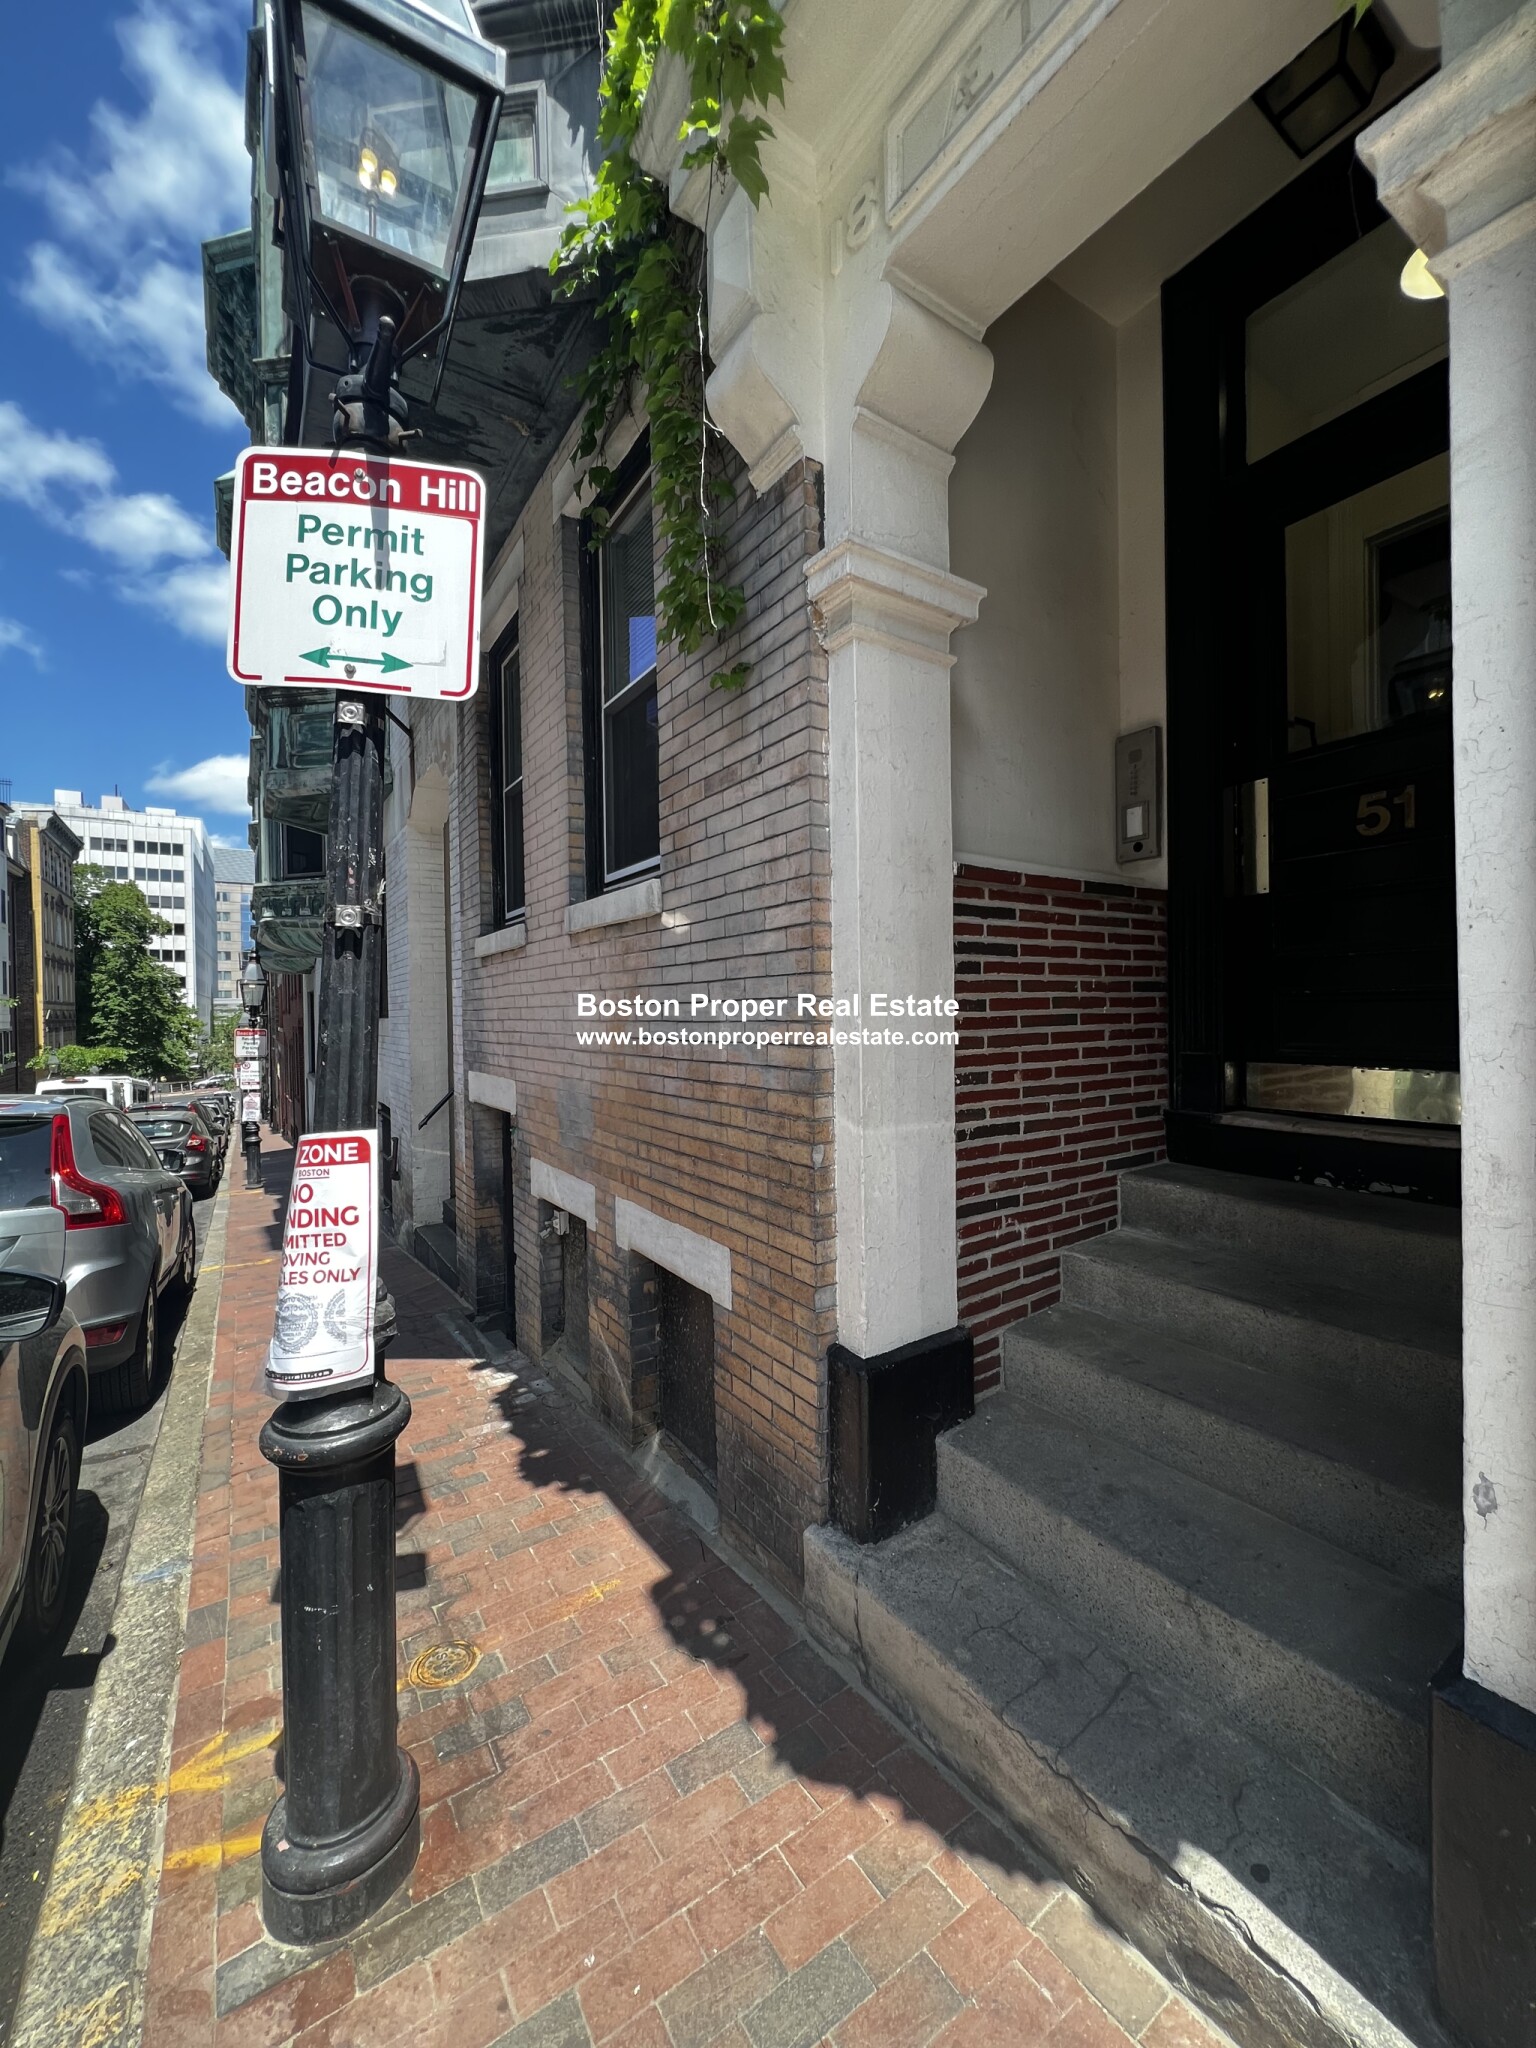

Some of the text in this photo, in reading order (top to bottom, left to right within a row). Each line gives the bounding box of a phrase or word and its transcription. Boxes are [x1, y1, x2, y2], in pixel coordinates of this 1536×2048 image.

[252, 462, 477, 513] Beacon Hill
[297, 513, 425, 556] Permit
[286, 553, 433, 603] Parking
[312, 594, 403, 637] Only
[1356, 784, 1415, 836] 51
[298, 1168, 330, 1177] BOSTON
[299, 1142, 359, 1165] ZONE
[312, 1267, 362, 1285] ONLY
